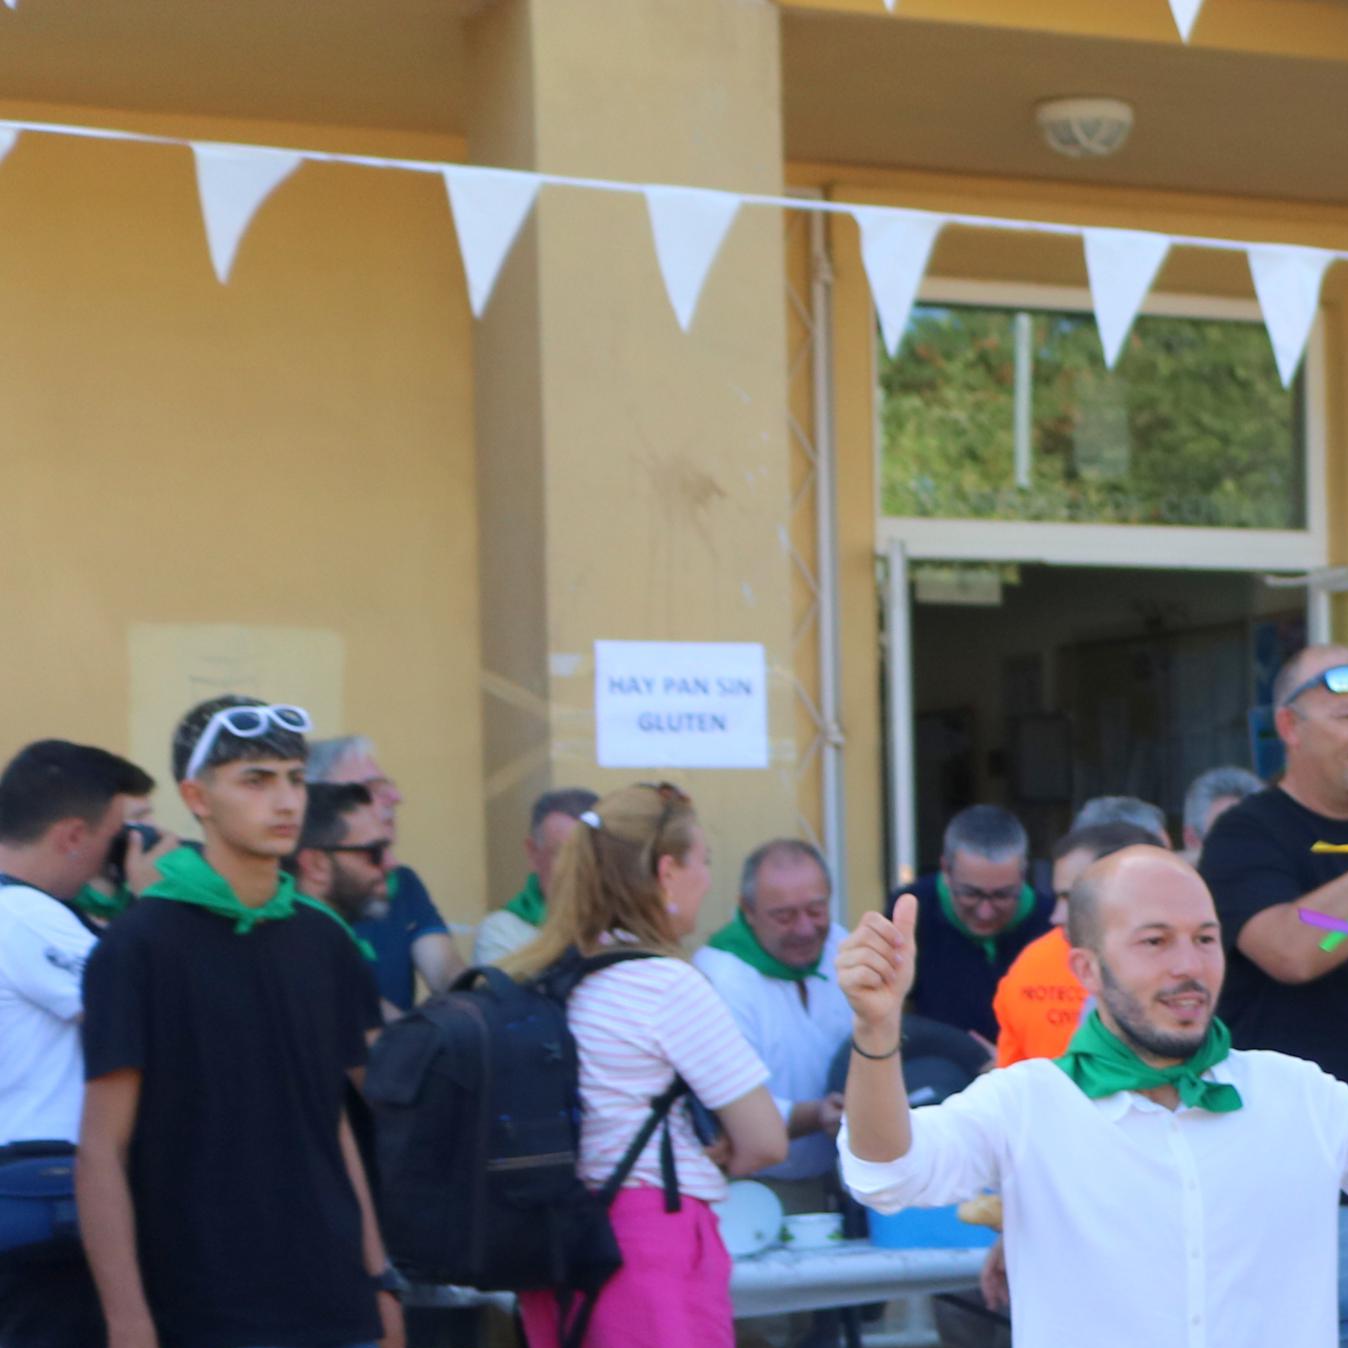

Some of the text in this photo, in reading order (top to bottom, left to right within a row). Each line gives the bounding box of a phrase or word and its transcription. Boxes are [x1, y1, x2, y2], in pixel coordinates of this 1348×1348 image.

[607, 676, 753, 696] HAY PAN SIN
[637, 711, 727, 733] GLUTEN
